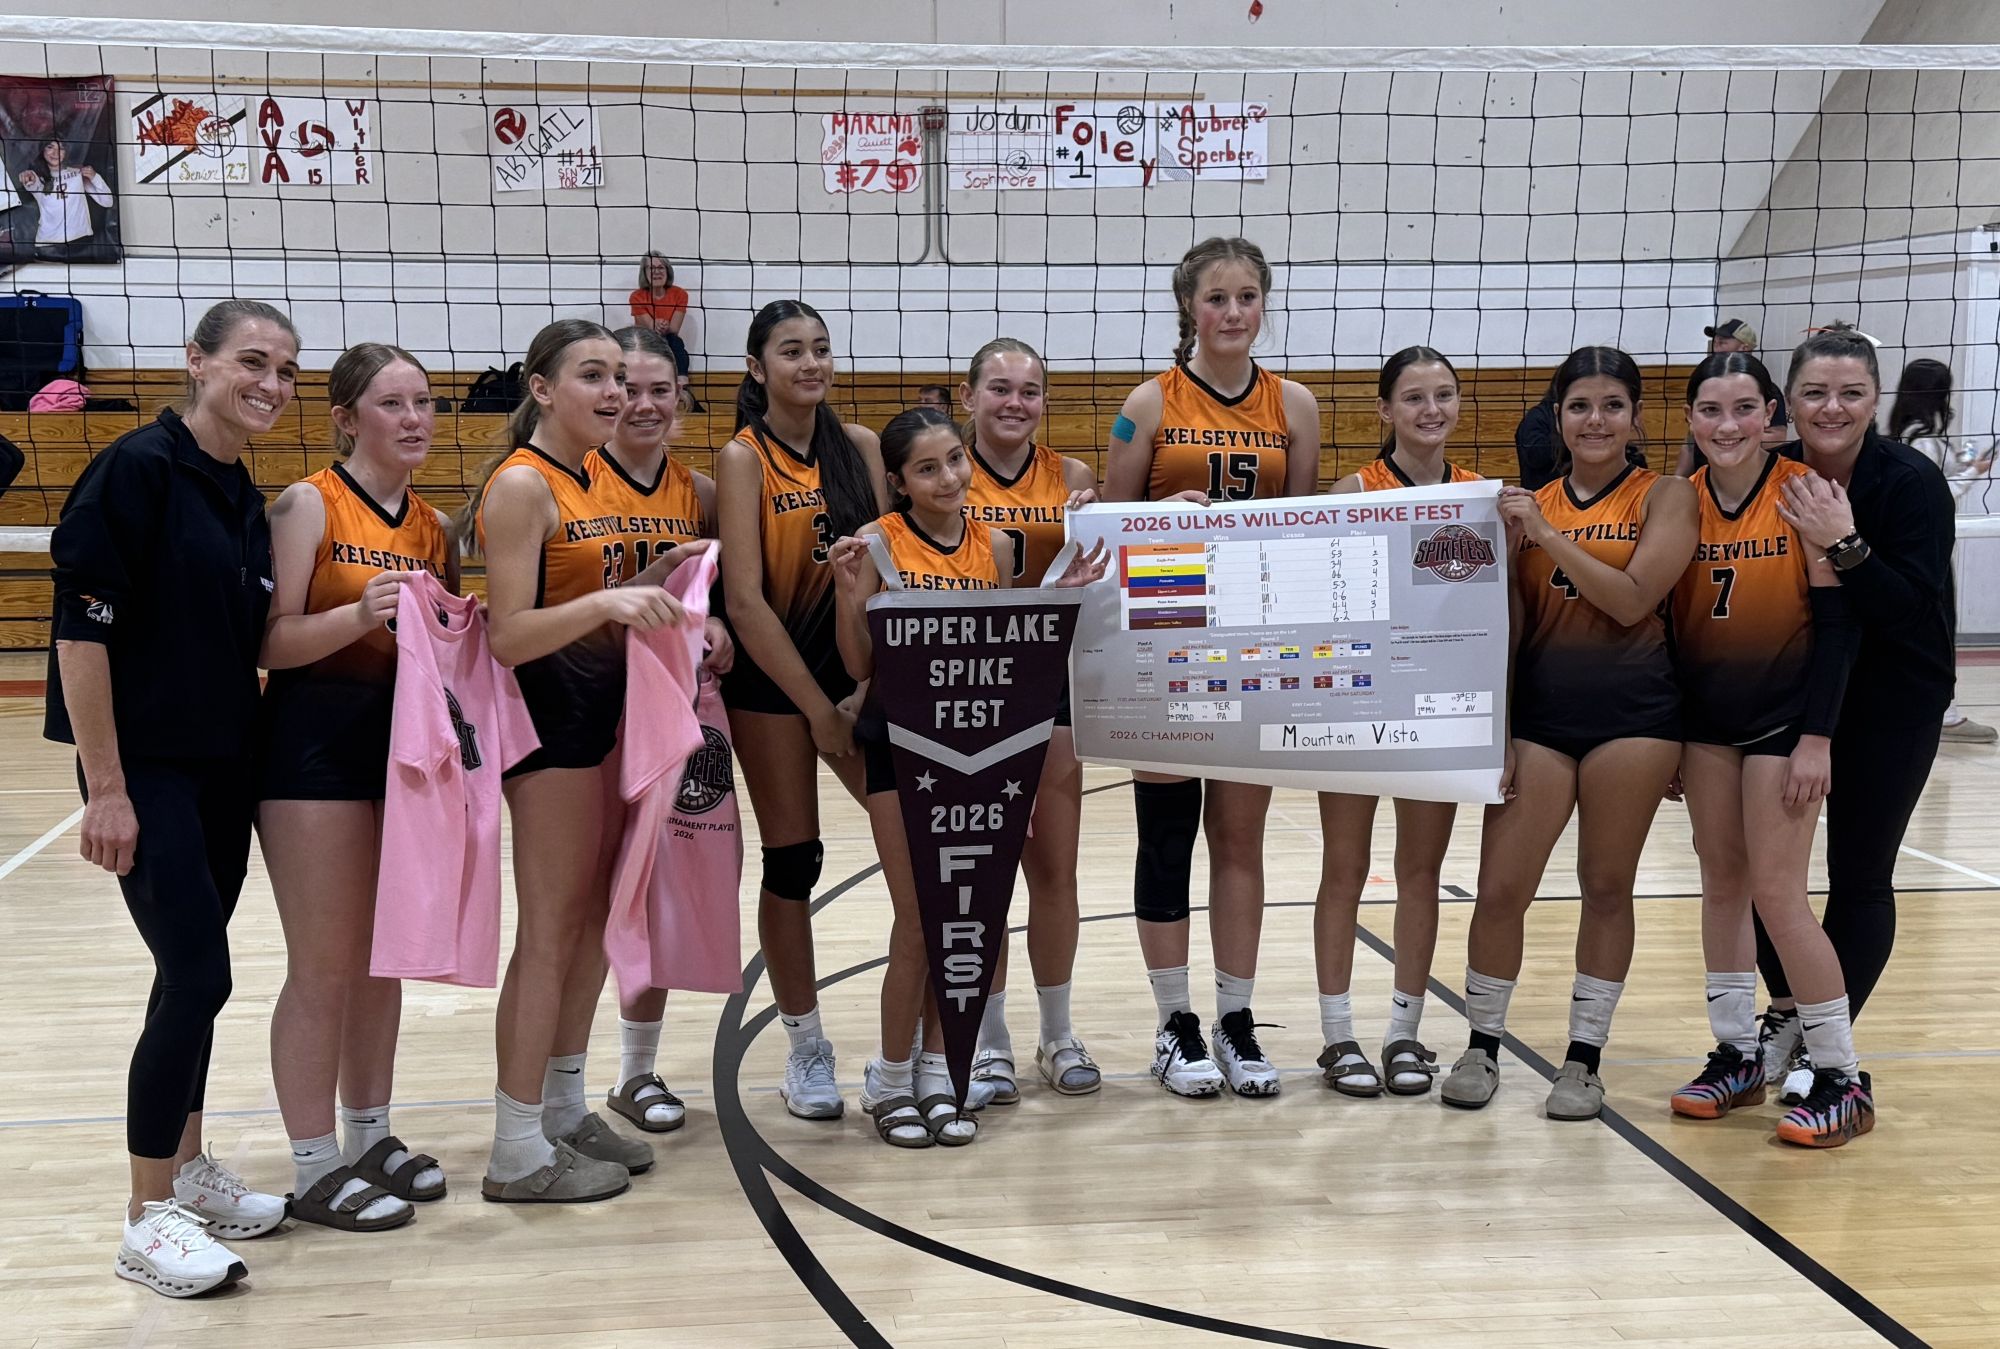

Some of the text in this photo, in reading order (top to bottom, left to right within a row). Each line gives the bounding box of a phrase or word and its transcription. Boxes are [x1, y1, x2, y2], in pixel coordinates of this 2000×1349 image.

[832, 112, 912, 135] MARINA
[966, 104, 1042, 133] Jodyn
[258, 98, 290, 183] AVA
[496, 107, 584, 189] ABIGAIL
[1177, 135, 1254, 176] Sperber
[582, 166, 602, 186] 27
[1164, 427, 1289, 450] KELSEYVILLE
[1206, 451, 1260, 500] 15
[960, 505, 1065, 523] ELSEYVILL
[1121, 503, 1465, 533] 2026 ULMS WILDCAT SPIKE FEST
[811, 511, 834, 565] 3
[1414, 538, 1497, 564] SPIKEFEST
[1696, 535, 1788, 562] SEYVILLE
[1710, 565, 1738, 619] 7
[886, 613, 1060, 647] UPPER LAKE
[929, 657, 1014, 688] SPIKE
[1214, 702, 1231, 711] TER
[1465, 692, 1477, 701] EP
[1465, 705, 1476, 713] AV
[935, 699, 1005, 729] FEST
[1109, 730, 1215, 742] 2026 CHAMPION
[1281, 722, 1420, 748] Mountain Vista
[930, 802, 1004, 834] 2026
[673, 829, 695, 841] 2026
[939, 844, 994, 1014] FIRST
